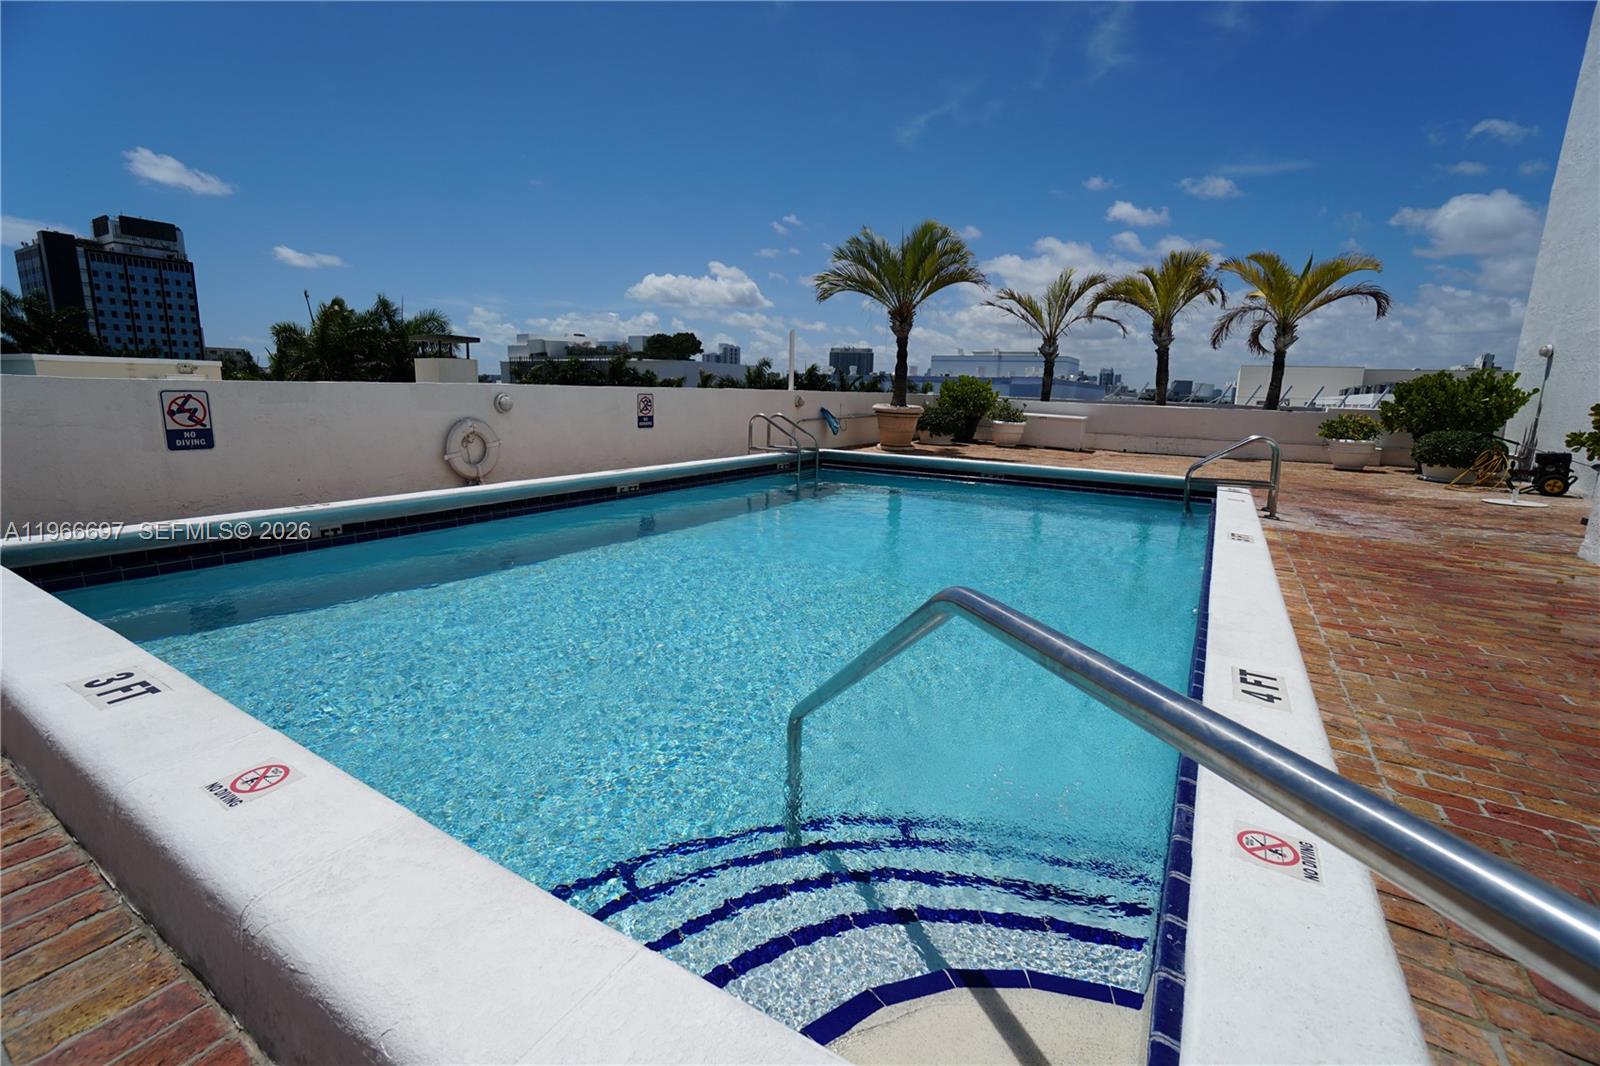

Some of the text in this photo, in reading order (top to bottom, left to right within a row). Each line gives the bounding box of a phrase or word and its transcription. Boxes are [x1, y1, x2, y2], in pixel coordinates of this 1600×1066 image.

[175, 438, 206, 446] DIVING
[84, 672, 162, 704] 3 FT
[1239, 668, 1282, 703] 4 FT
[205, 782, 243, 807] NO DIVING
[1299, 841, 1320, 882] NO DIVING
